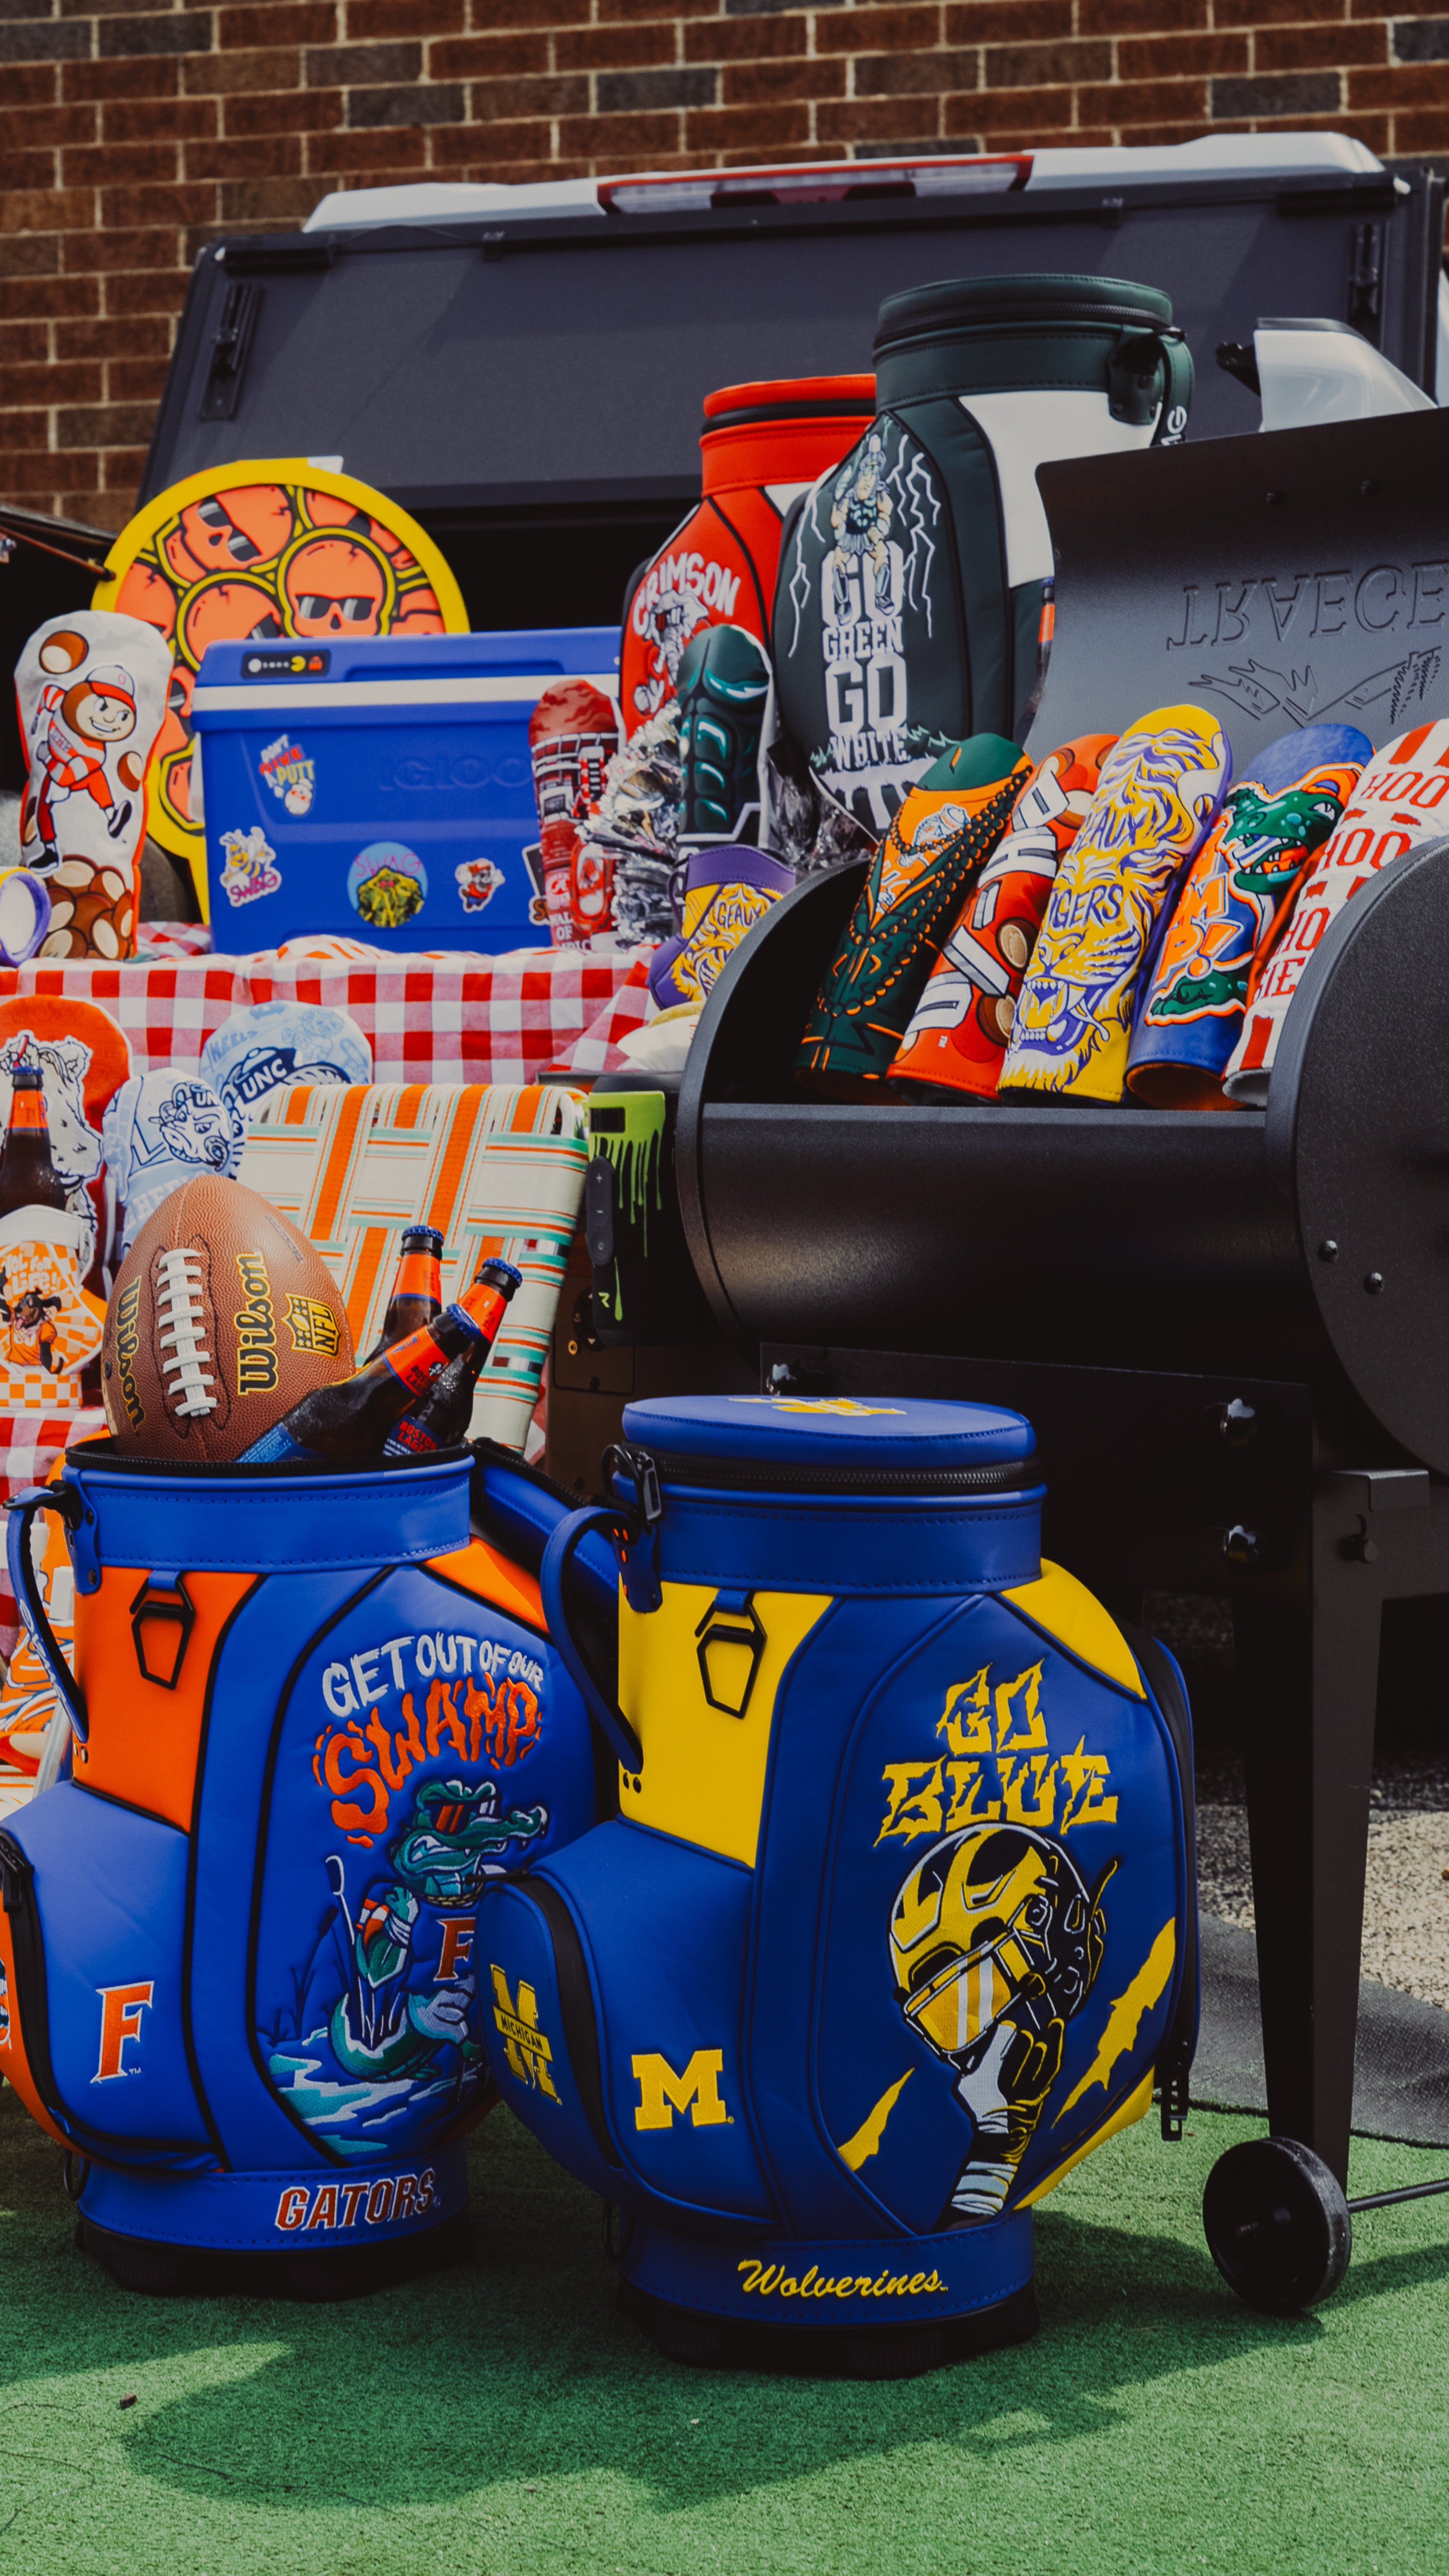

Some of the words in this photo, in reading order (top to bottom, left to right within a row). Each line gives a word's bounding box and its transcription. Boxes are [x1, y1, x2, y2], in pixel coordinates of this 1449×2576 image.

[633, 552, 740, 635] CRIMSON
[821, 541, 904, 628] GO
[823, 616, 904, 663] GREEN
[825, 652, 907, 736] GO
[259, 746, 303, 774] GIVE
[276, 760, 314, 785] PUTT
[830, 724, 908, 771] WHITE
[1361, 771, 1449, 808] HOO
[230, 871, 278, 902] SWAG
[355, 853, 421, 877] SWAG
[556, 925, 572, 940] OF
[242, 1058, 287, 1099] UNC
[233, 1251, 278, 1396] Wilson
[312, 1308, 336, 1351] NFL
[116, 1275, 145, 1432] Wilson
[322, 1635, 416, 1718] GET
[415, 1631, 477, 1677] OUT
[479, 1639, 511, 1675] OF
[508, 1650, 545, 1691] OUR
[936, 1658, 1048, 1756] GO
[323, 1672, 540, 1835] SWAMP
[873, 1735, 1118, 1847] BLUE
[90, 1980, 155, 2083] F
[500, 2013, 544, 2051] MICHIGAN
[631, 2049, 727, 2131] M
[274, 2167, 436, 2232] GATORS
[737, 2258, 941, 2298] Wolverines
